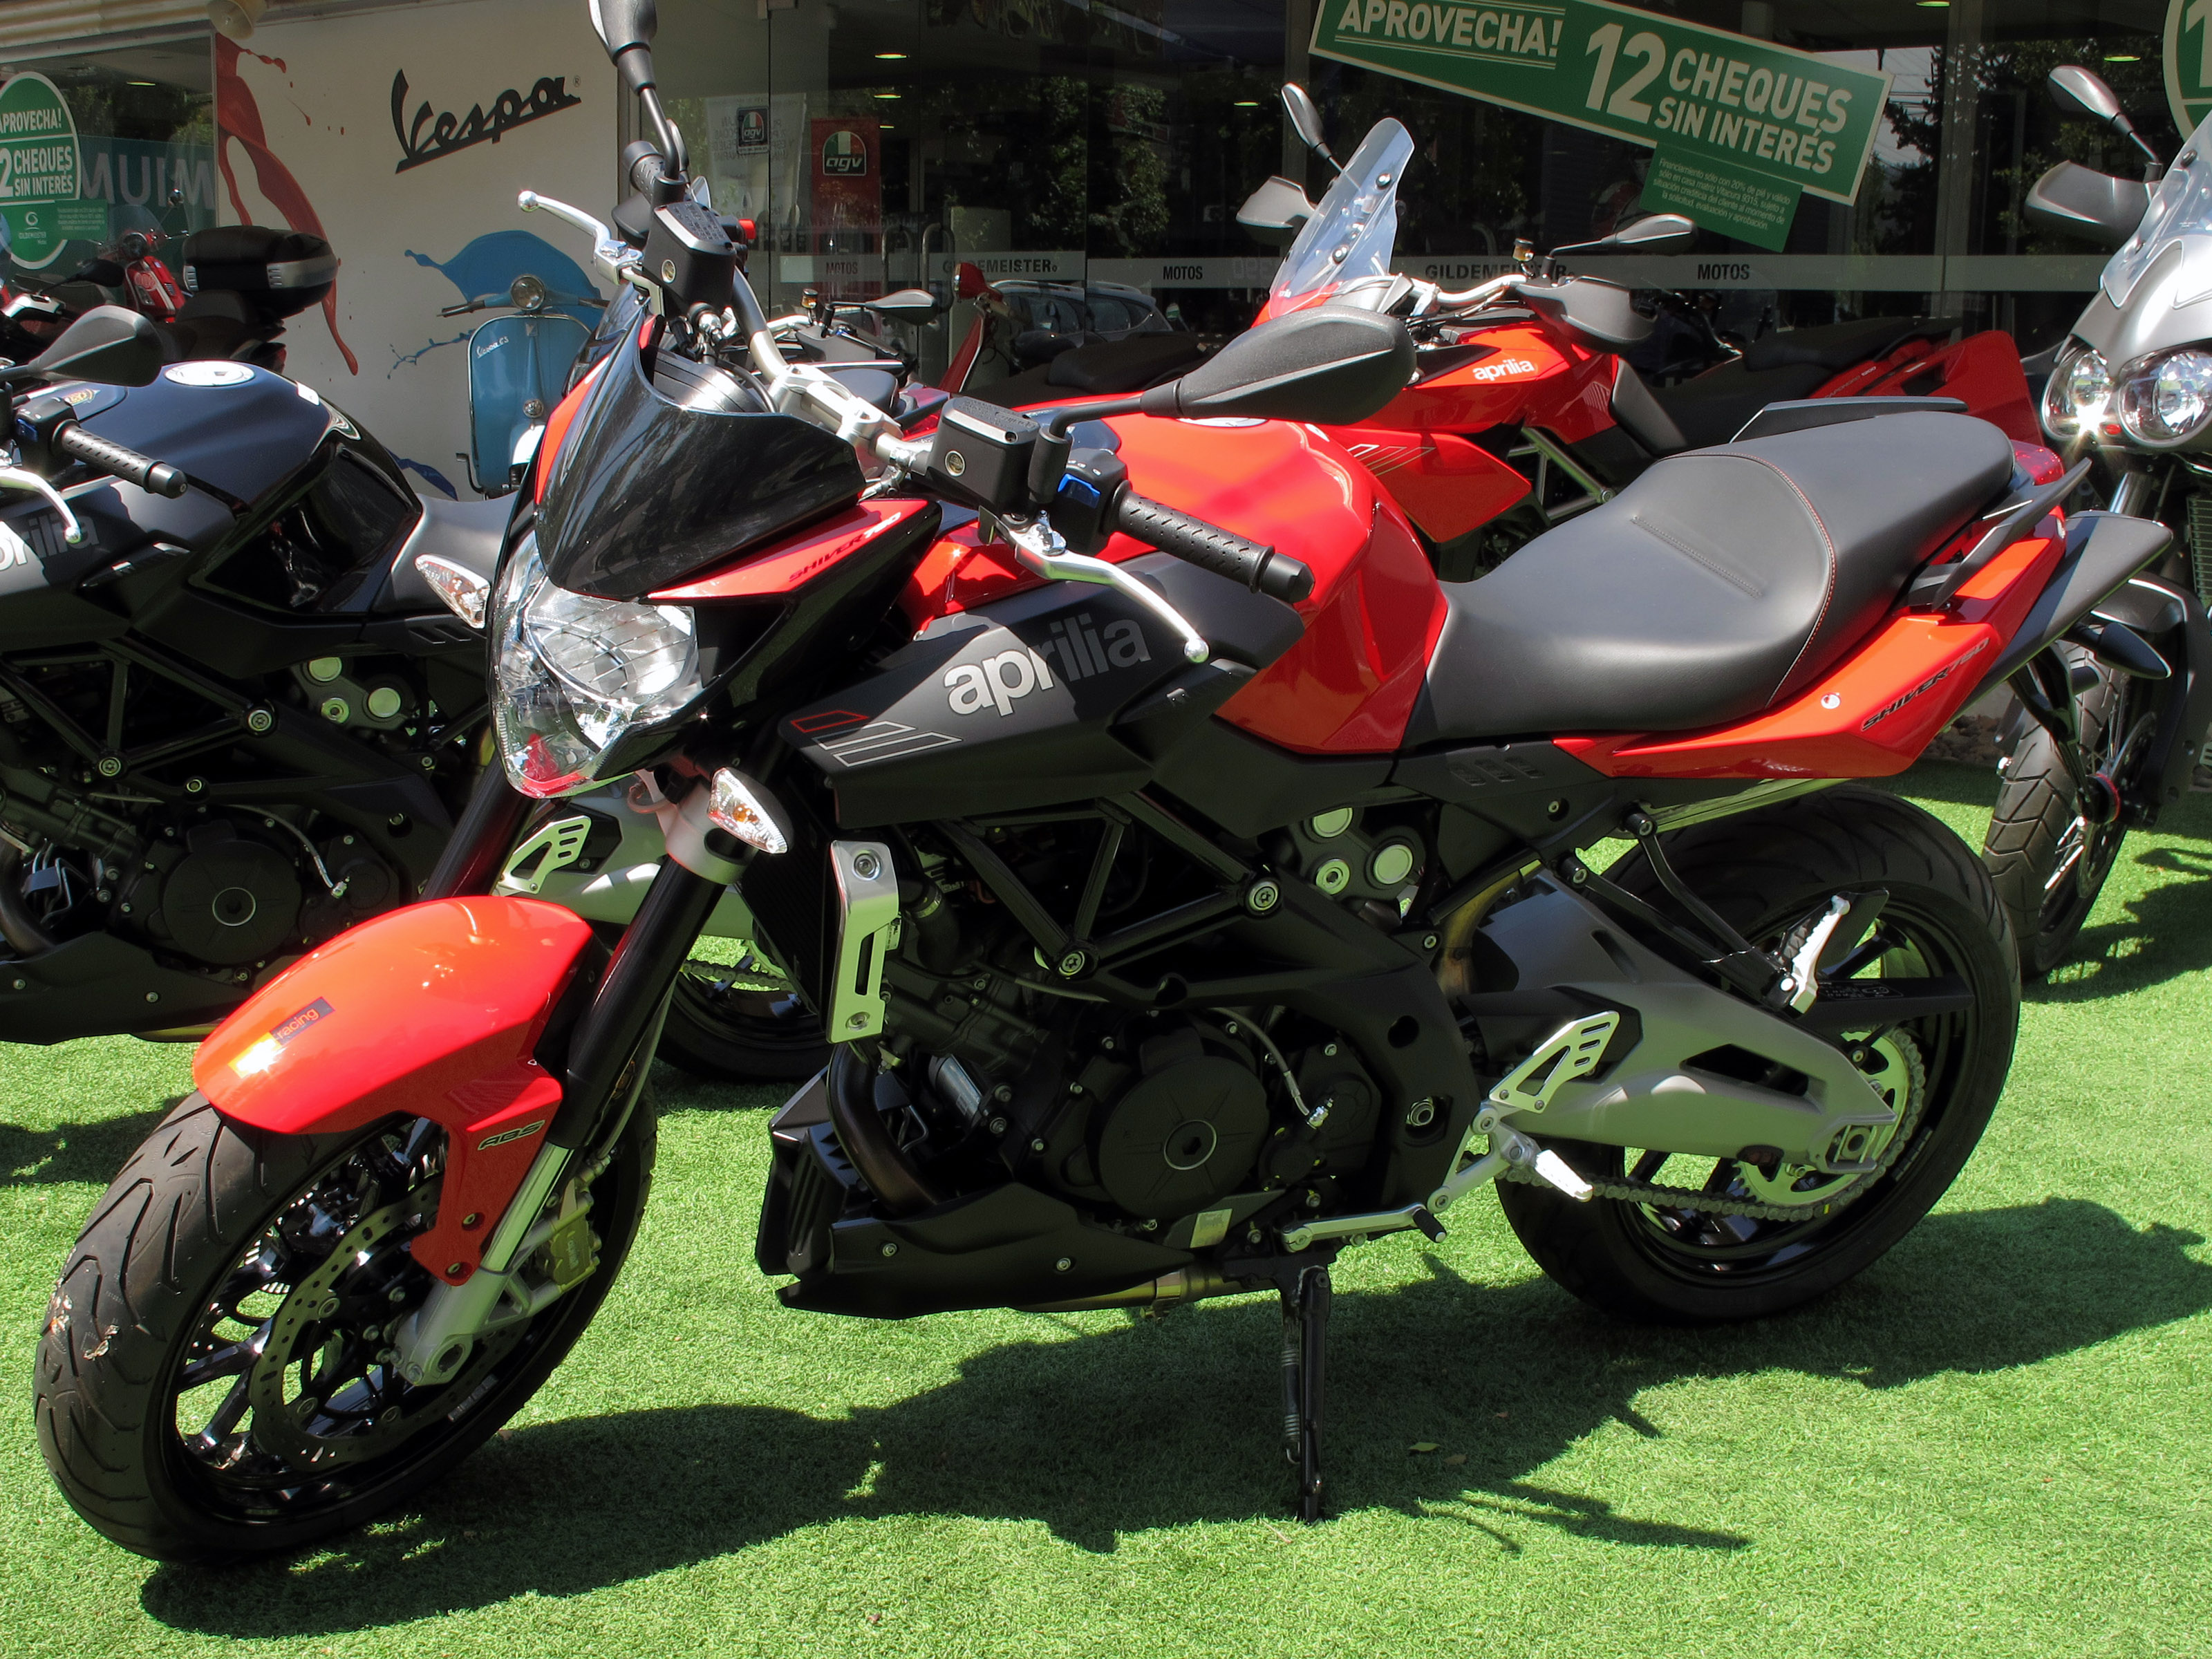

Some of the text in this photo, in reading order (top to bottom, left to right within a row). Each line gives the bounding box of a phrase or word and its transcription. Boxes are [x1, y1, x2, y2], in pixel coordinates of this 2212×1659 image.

[1338, 0, 1564, 57] APROVECHA!
[1585, 23, 1667, 124] 12
[1669, 48, 1853, 134] CHEQUES
[391, 68, 582, 174] Vespa
[744, 128, 762, 140] agv
[1654, 97, 1837, 174] SIN INTERÉS
[14, 146, 73, 174] CHEQUES
[826, 156, 863, 172] agv
[15, 170, 73, 197] SIN INTERÉS
[826, 262, 858, 275] MOTOS
[1163, 265, 1203, 280] MOTOS
[1698, 264, 1750, 280] MOTOS
[1472, 358, 1535, 381] aprilia
[789, 534, 863, 582] SHIVER
[944, 612, 1152, 717] aprilia
[1861, 637, 1990, 731] SHIVER 750
[276, 1009, 319, 1039] racing
[478, 1120, 545, 1150] ABS
